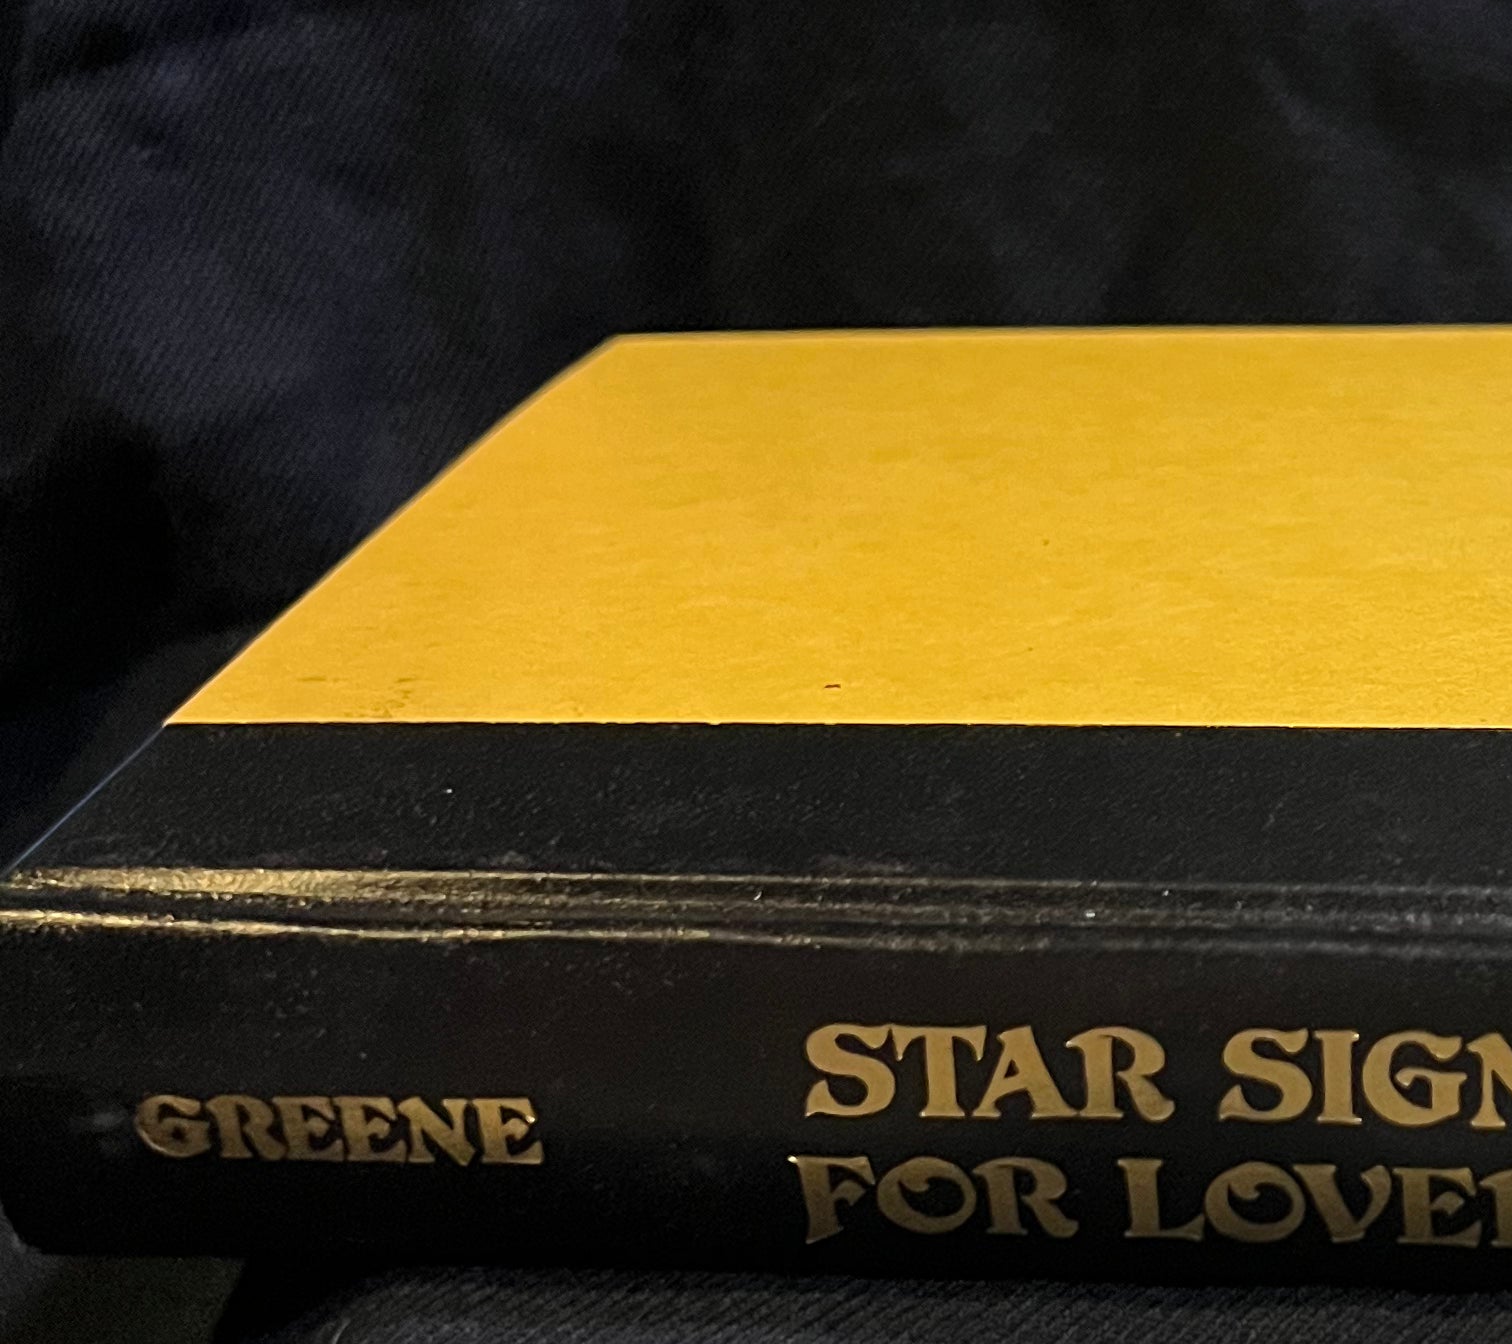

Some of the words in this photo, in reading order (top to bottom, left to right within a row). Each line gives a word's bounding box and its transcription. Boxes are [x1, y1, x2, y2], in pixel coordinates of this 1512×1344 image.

[804, 1023, 1174, 1121] STAR
[134, 1094, 544, 1165] GREENE
[791, 1154, 1078, 1244] FOR
